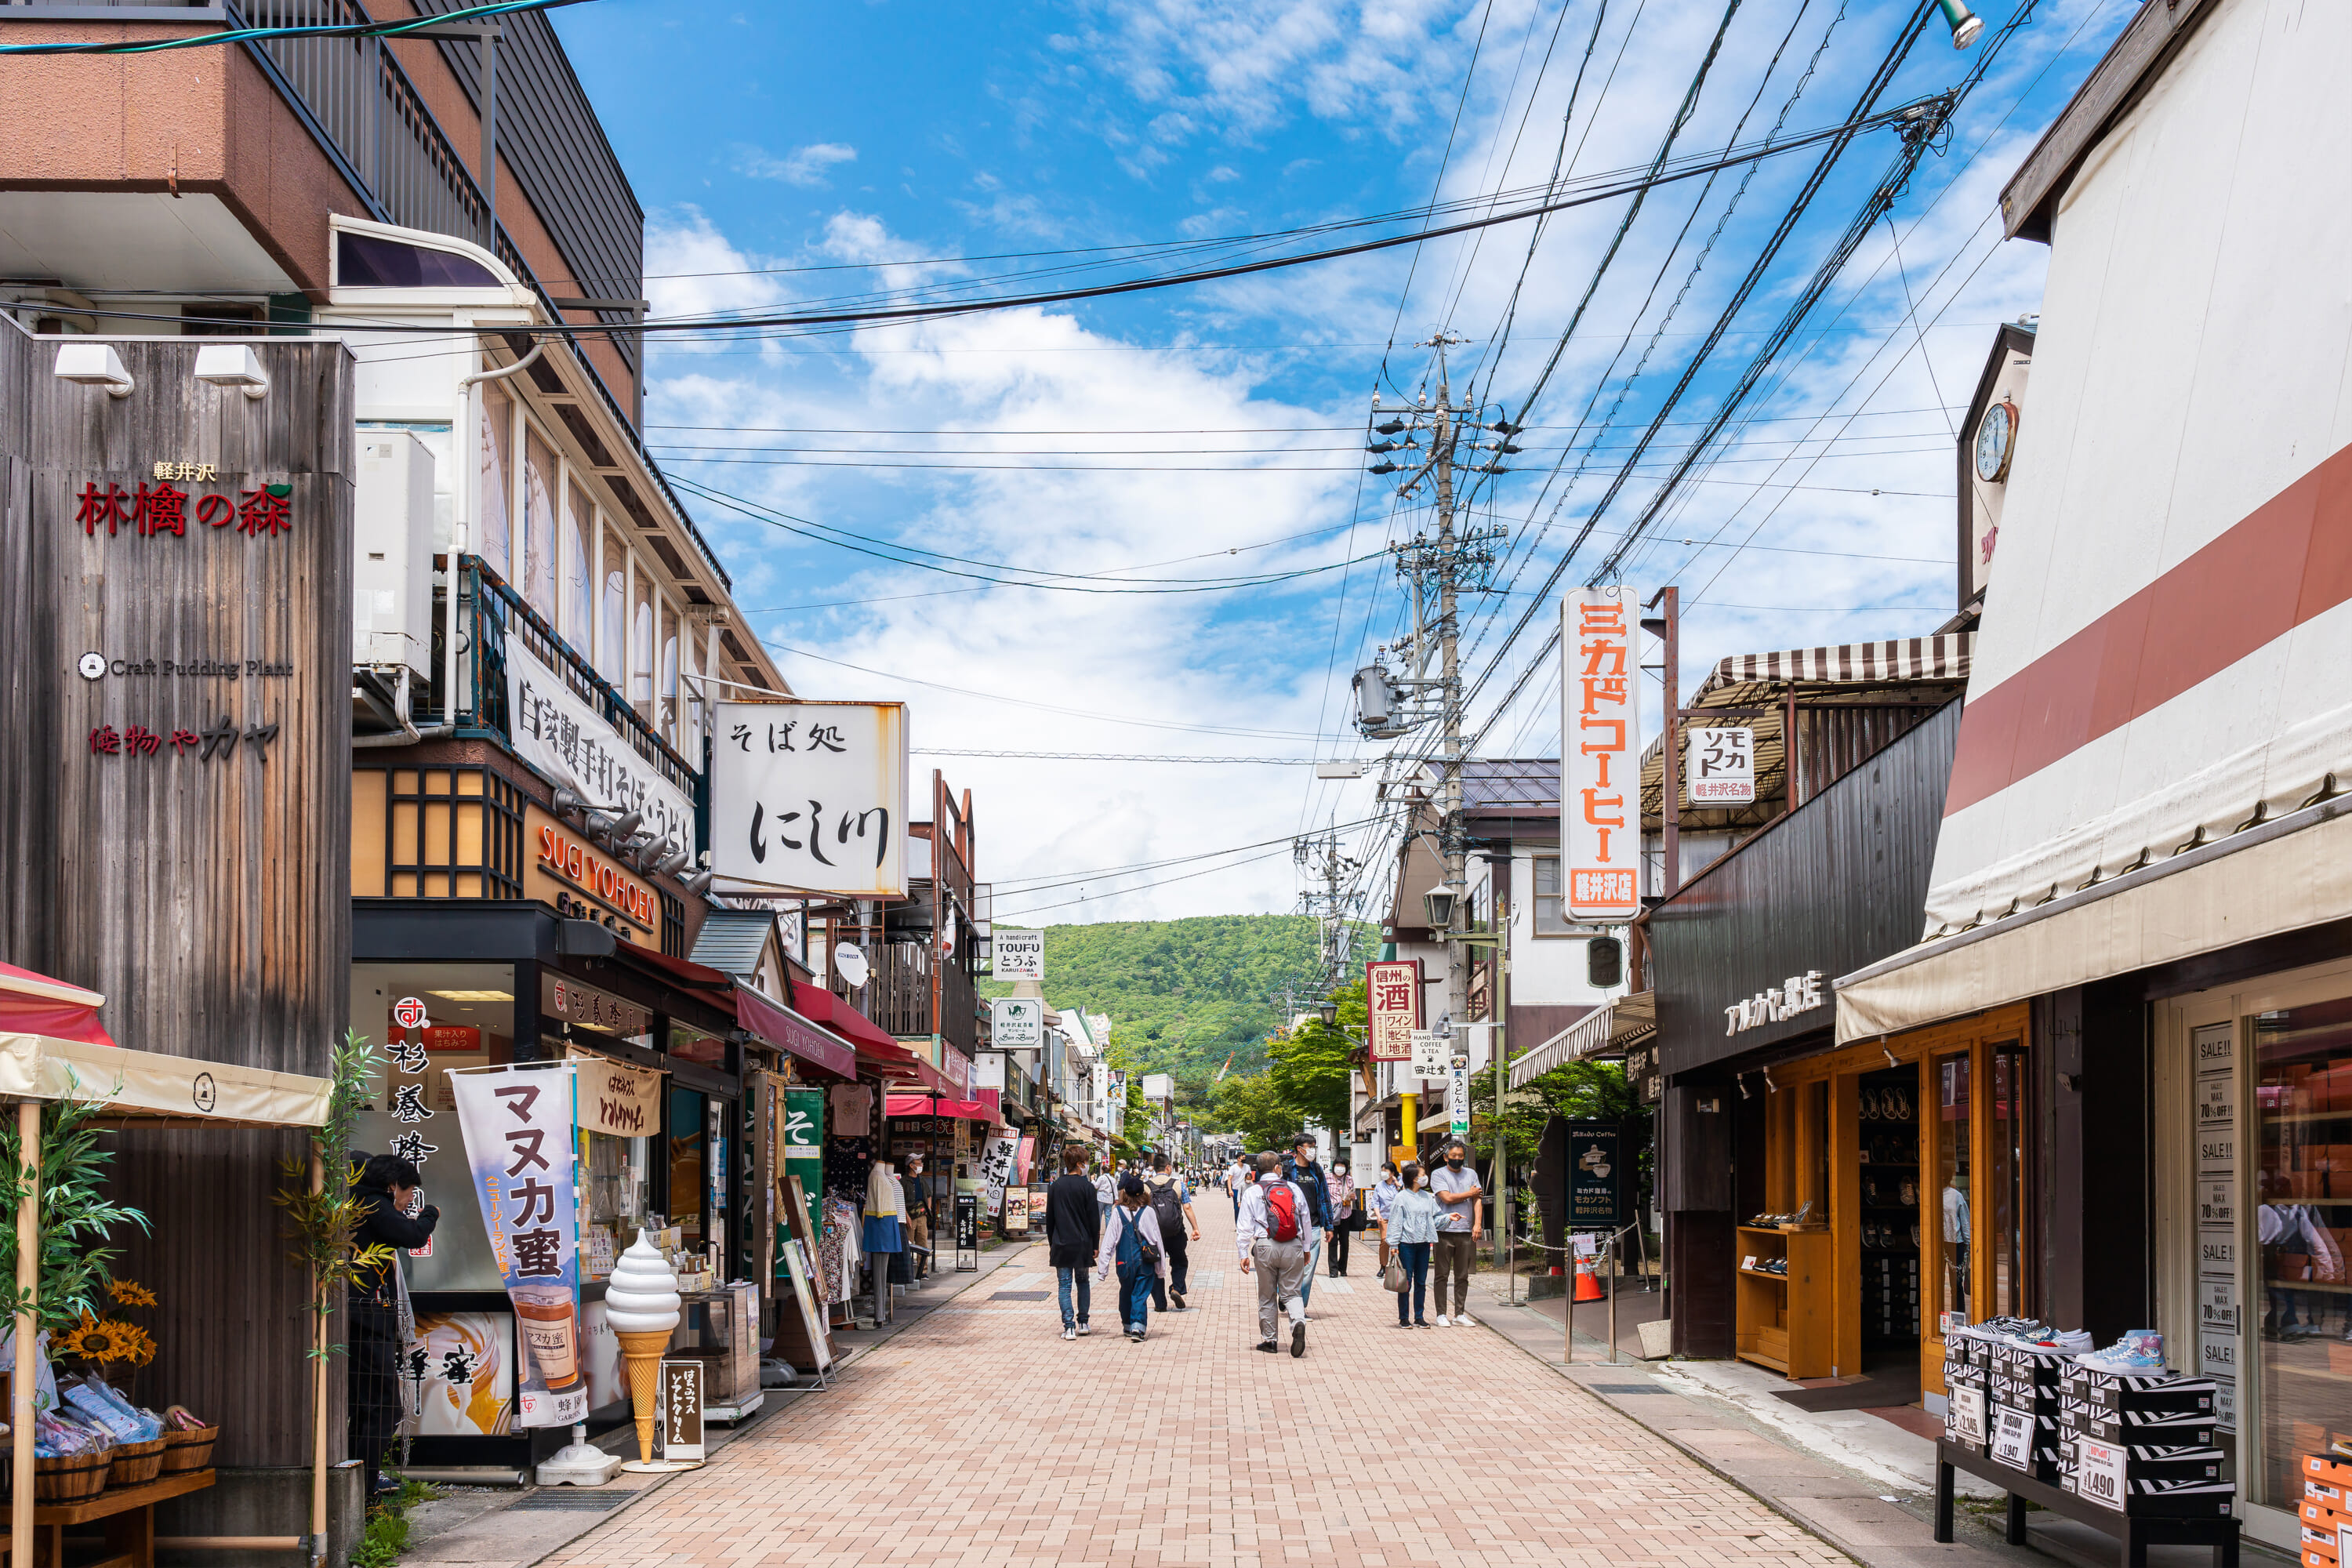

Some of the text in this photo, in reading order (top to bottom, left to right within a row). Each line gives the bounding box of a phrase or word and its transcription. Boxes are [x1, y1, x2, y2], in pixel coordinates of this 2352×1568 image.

[154, 461, 216, 482] 軽井沢
[76, 482, 292, 536] 林檎の森
[111, 659, 293, 680] Craft Pudding Plant
[88, 715, 278, 761] 倭物やカヤ
[730, 720, 847, 753] そば処
[1579, 601, 1628, 863] ミカドコーヒー
[1702, 730, 1723, 778] ソフト
[1726, 731, 1745, 769] モカ
[1695, 782, 1751, 798] 軽井沢名物
[750, 800, 888, 869] にし川
[538, 826, 584, 881] SUGI
[586, 856, 656, 925] YOHOEN
[1575, 871, 1632, 903] 軽井沢店
[997, 943, 1040, 953] TOUFU
[1001, 955, 1037, 967] とうふ
[1376, 969, 1411, 983] 信州の
[1376, 982, 1410, 1011] 酒
[1387, 1015, 1412, 1027] ワイン
[434, 1029, 466, 1038] 果汁入り
[434, 1040, 468, 1048] はちみつ
[786, 1025, 825, 1061] SUGI YOHOEN
[1388, 1029, 1412, 1041] 地ビール
[1388, 1044, 1412, 1054] 地酒
[2201, 1040, 2230, 1058] SALE!!
[1648, 1073, 1662, 1099] 軽井
[2211, 1092, 2223, 1102] MAX
[2201, 1142, 2233, 1159] SALE!!
[982, 1148, 997, 1180] とう
[993, 1140, 1014, 1188] 軽井沢
[494, 1084, 564, 1279] マヌカ蜜
[1574, 1196, 1611, 1204] モカソフト
[2213, 1193, 2226, 1203] MAX
[2215, 1294, 2228, 1305] MAX
[684, 1369, 695, 1414] はちみつ入
[2220, 1396, 2233, 1407] MAX
[671, 1373, 685, 1444] ソフトクリーム
[1959, 1414, 1978, 1436] ¥2,145
[2004, 1413, 2023, 1429] VISION
[1999, 1443, 2019, 1459] ¥1,947
[2083, 1470, 2114, 1498] ¥1,490
